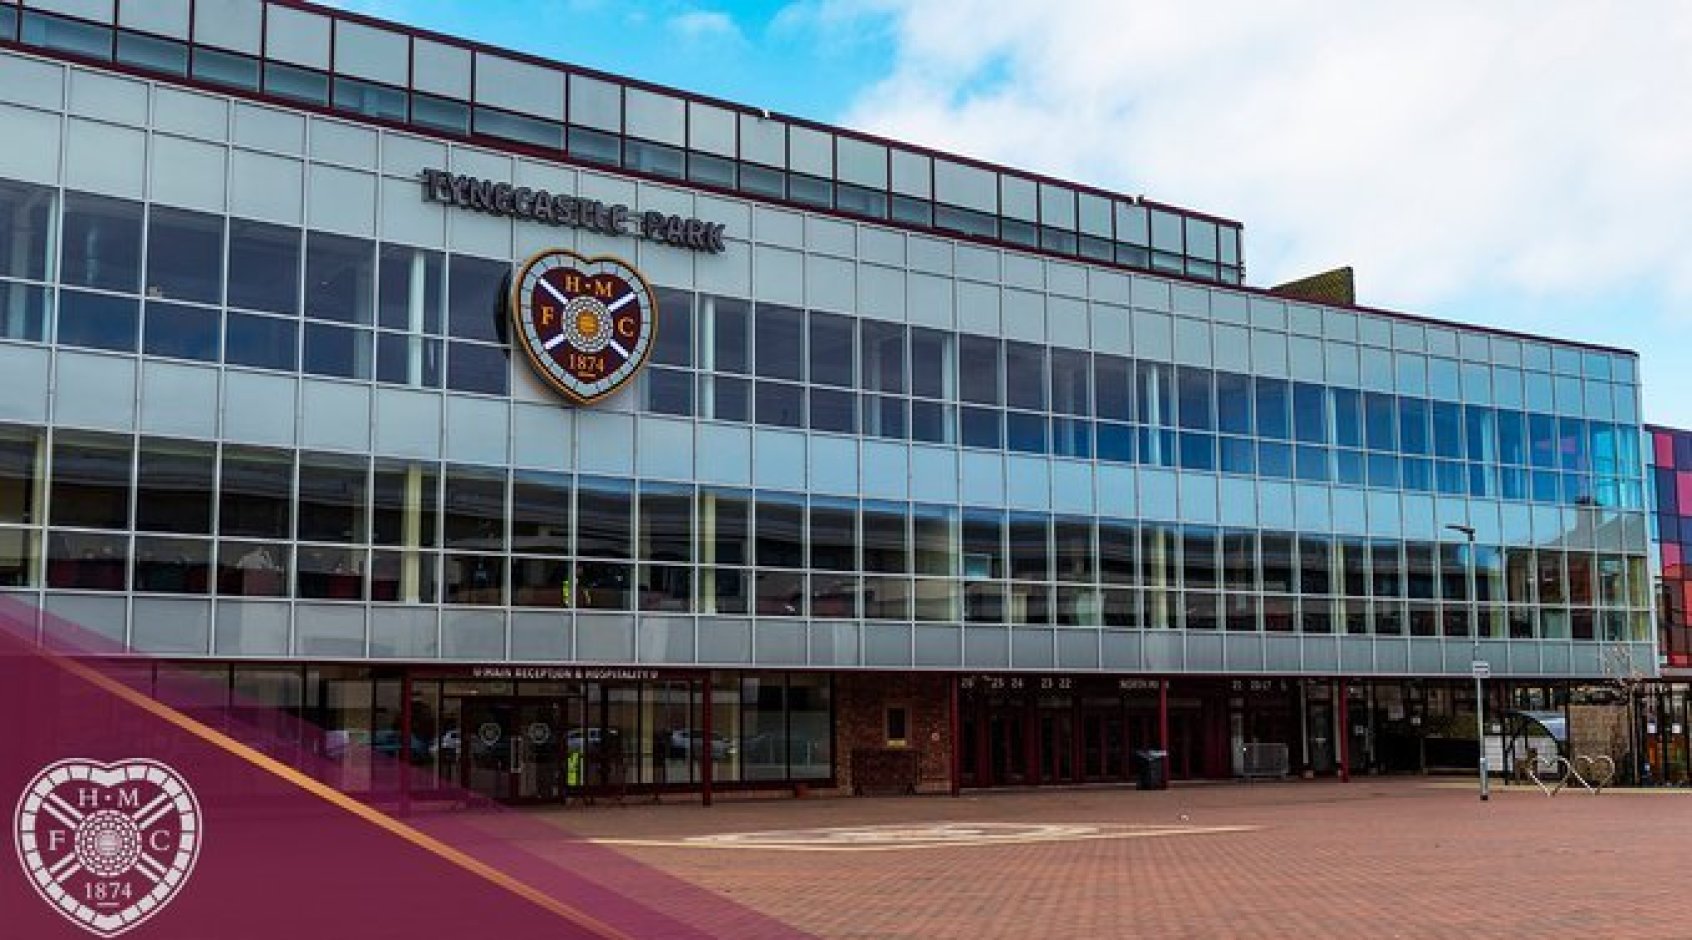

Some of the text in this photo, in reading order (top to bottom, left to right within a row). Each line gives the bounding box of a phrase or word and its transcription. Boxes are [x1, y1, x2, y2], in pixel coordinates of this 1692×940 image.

[421, 168, 726, 254] TYNECASTLE PARK
[541, 306, 634, 338] F C
[568, 354, 604, 372] 1874
